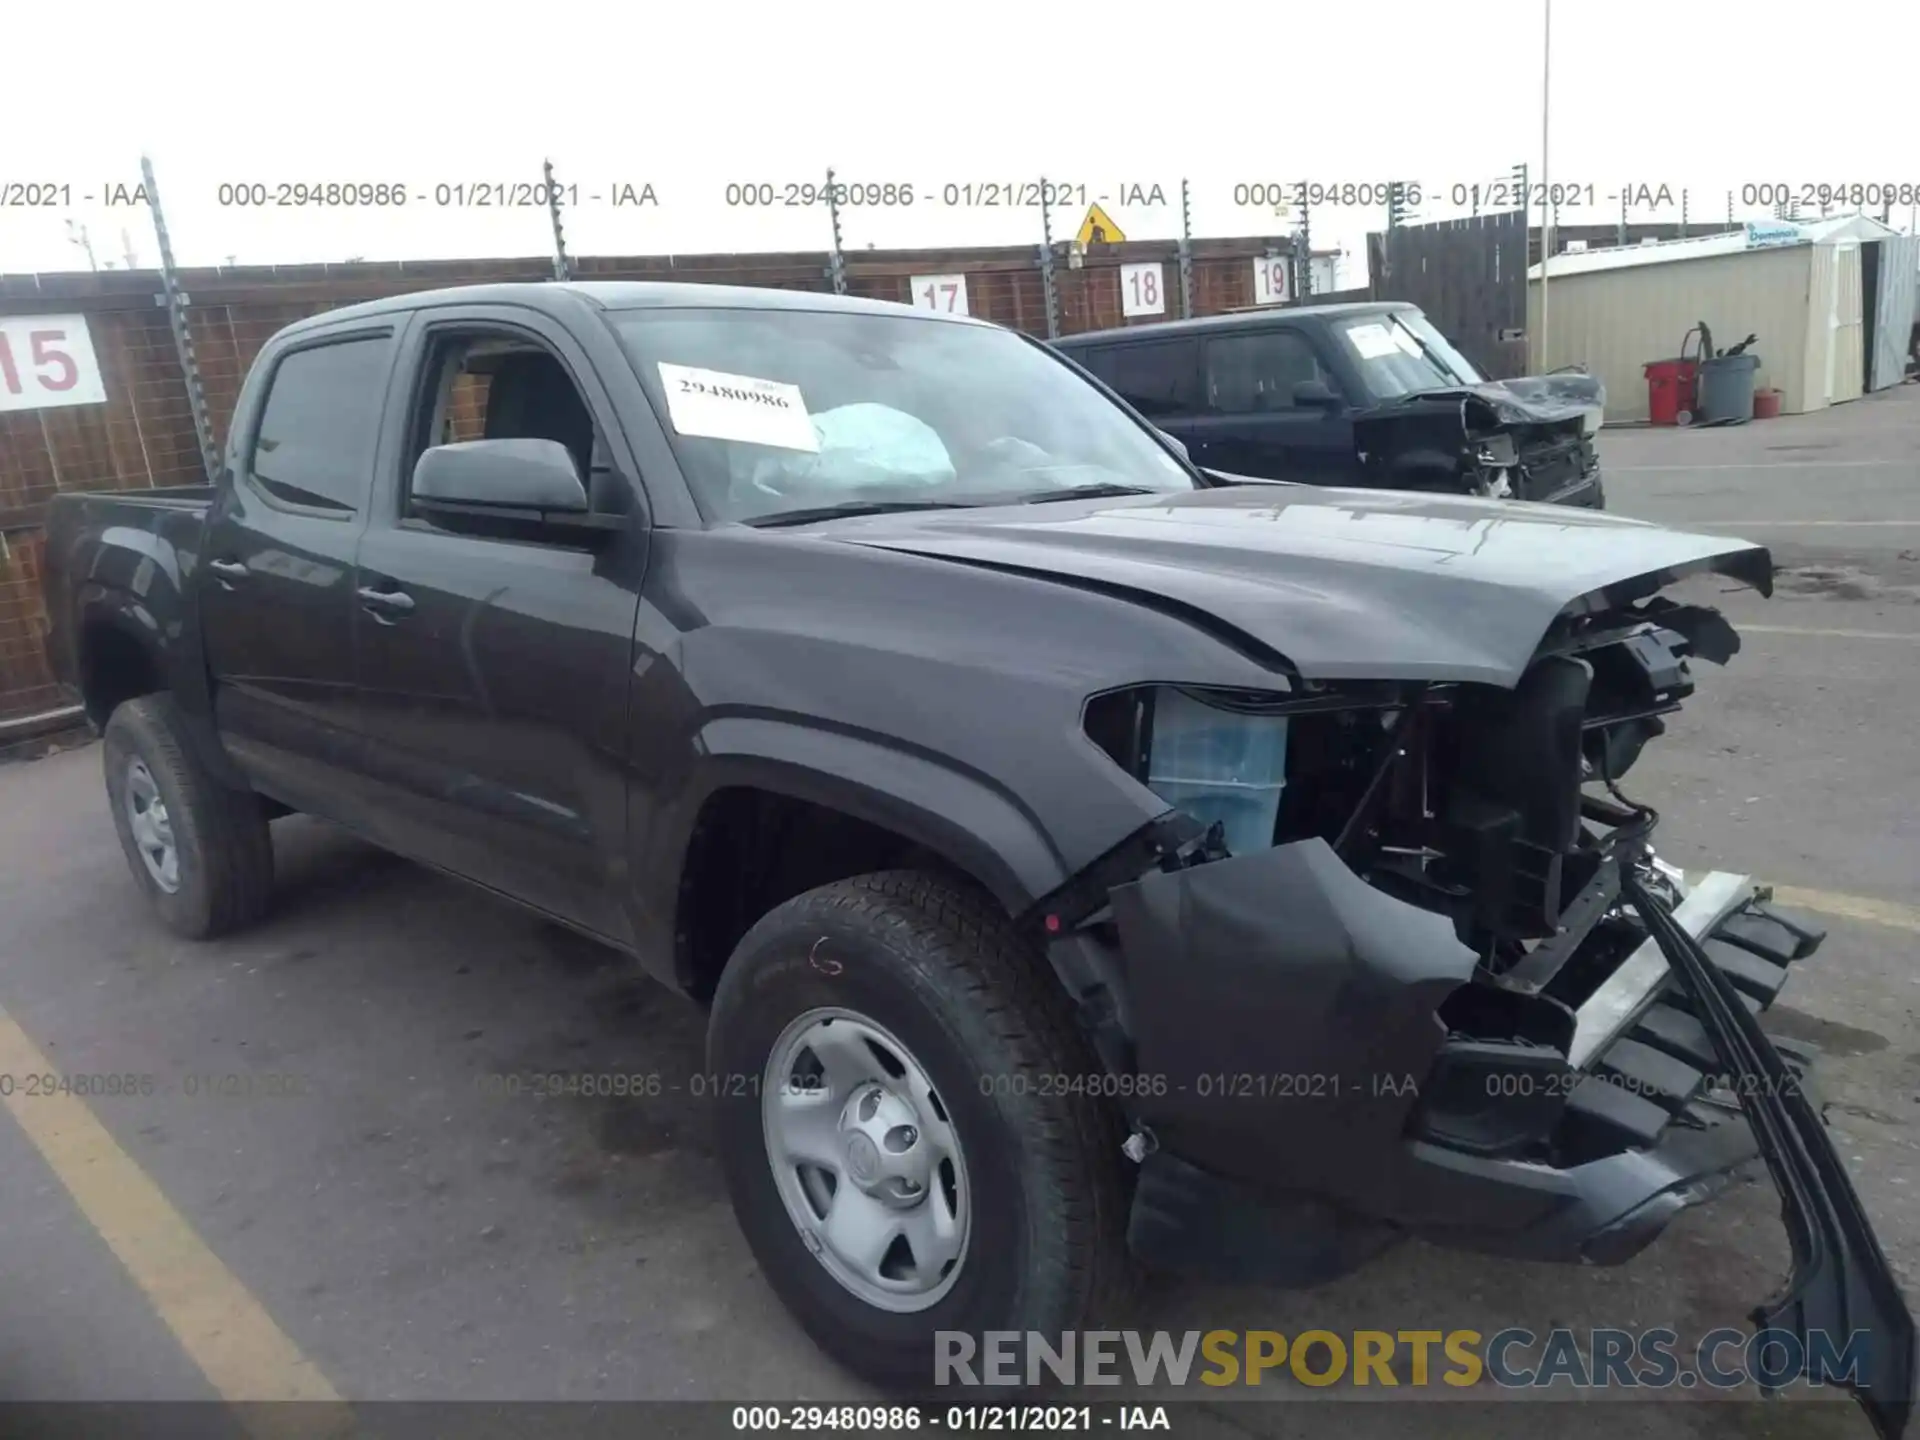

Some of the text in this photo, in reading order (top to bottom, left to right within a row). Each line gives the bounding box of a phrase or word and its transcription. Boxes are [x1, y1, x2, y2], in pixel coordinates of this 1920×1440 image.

[1129, 270, 1156, 306] 18
[1261, 262, 1284, 295] 19
[924, 283, 959, 312] 17
[0, 330, 79, 395] 15
[678, 379, 789, 409] 29480986
